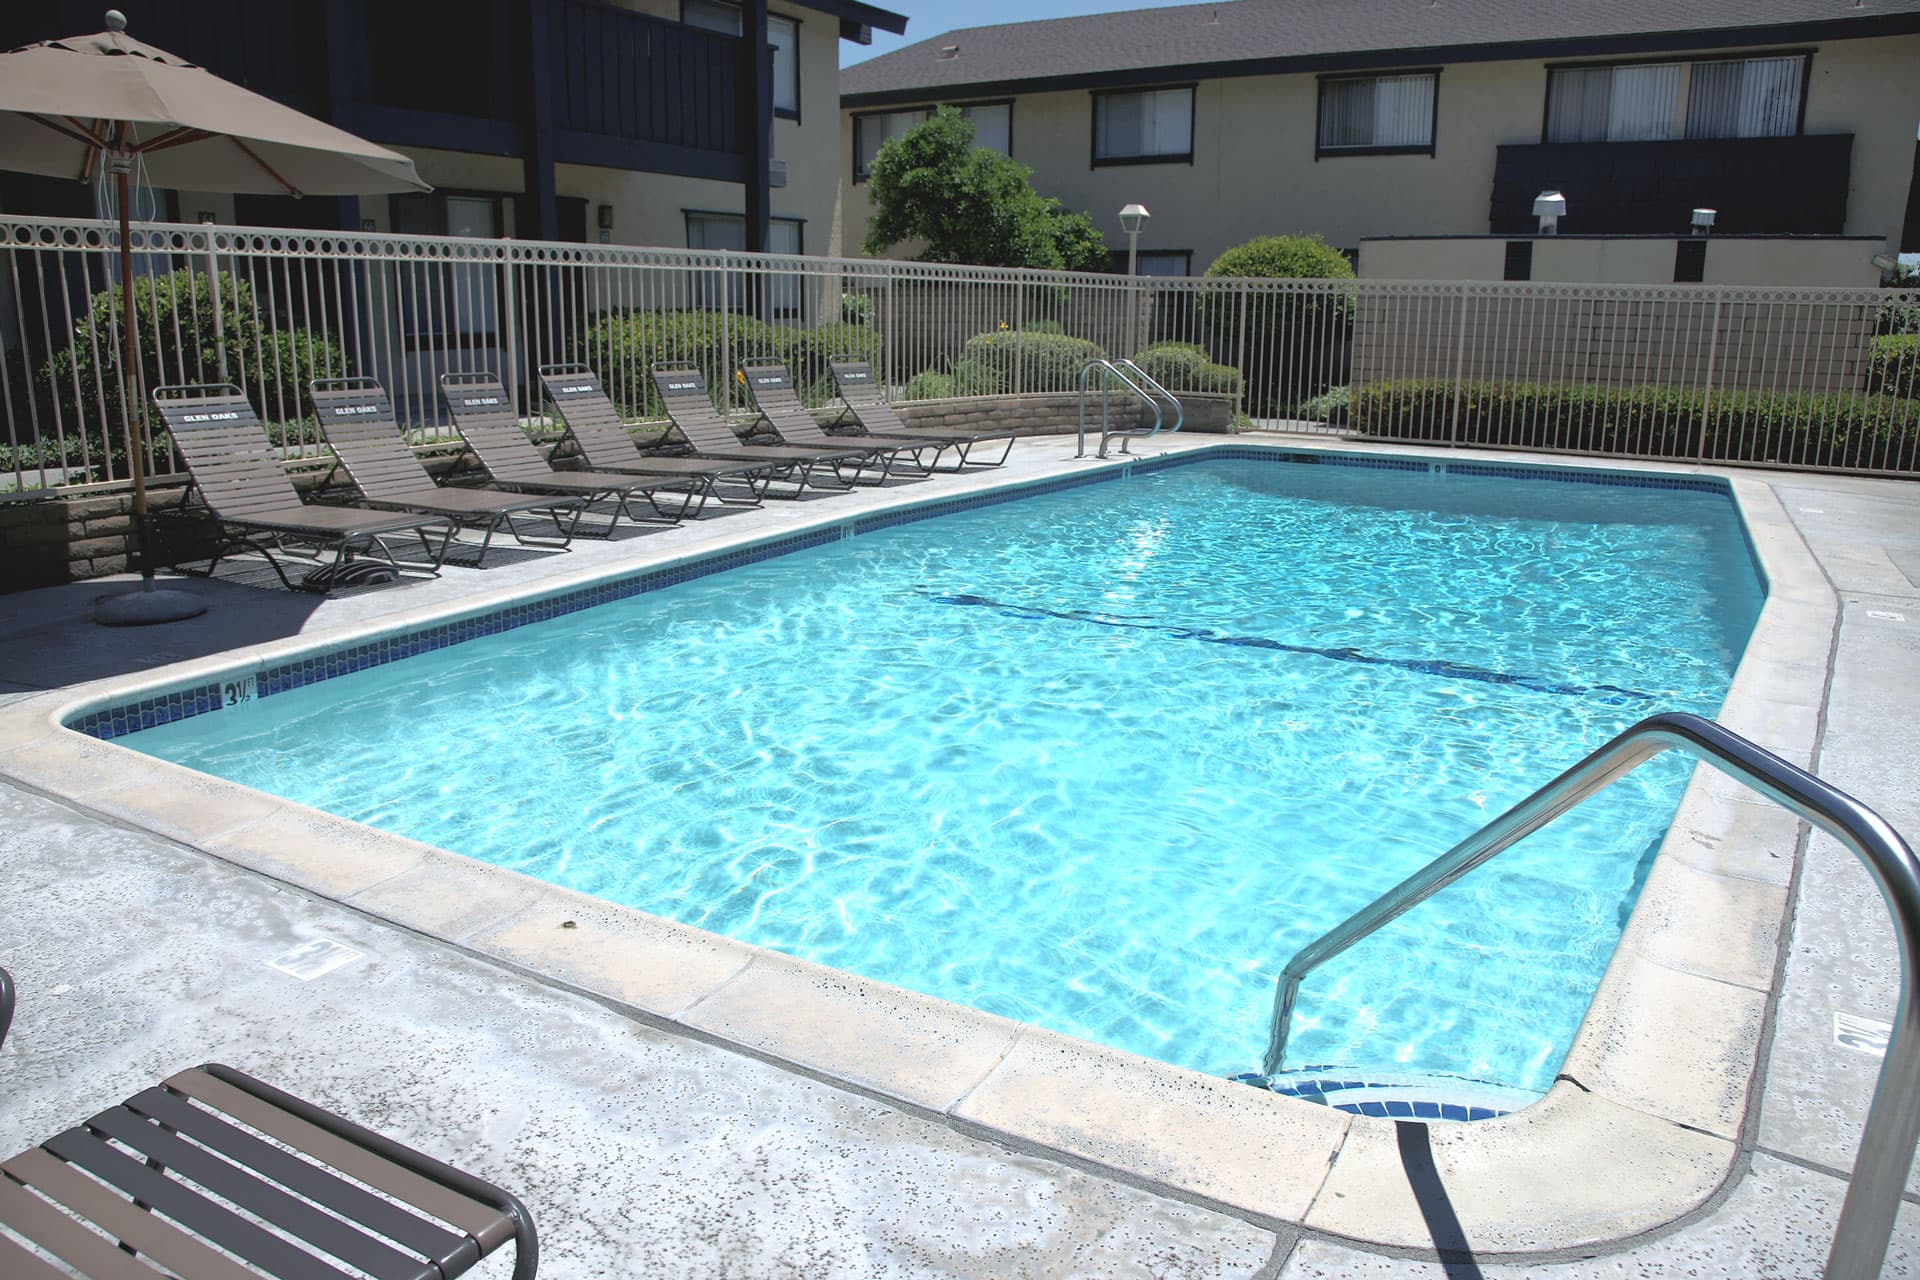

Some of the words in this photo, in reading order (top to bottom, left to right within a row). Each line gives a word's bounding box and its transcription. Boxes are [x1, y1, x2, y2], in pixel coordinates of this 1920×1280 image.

[335, 407, 356, 415] GLEN
[356, 405, 377, 413] OAKS
[211, 412, 238, 420] OAKS
